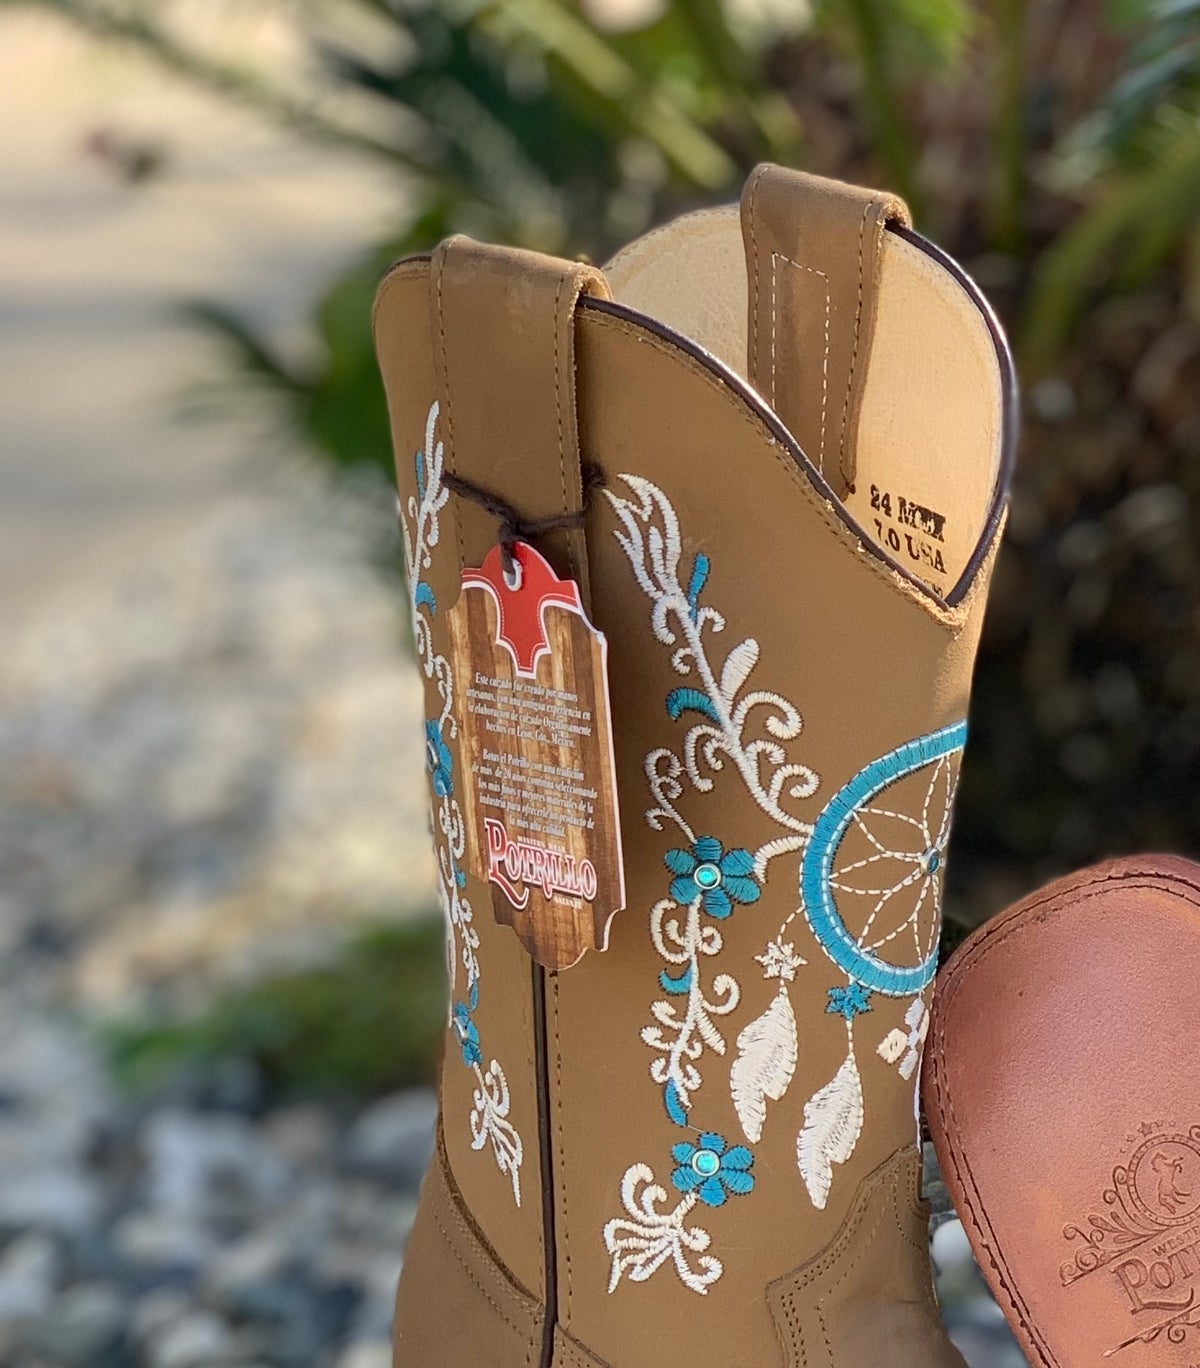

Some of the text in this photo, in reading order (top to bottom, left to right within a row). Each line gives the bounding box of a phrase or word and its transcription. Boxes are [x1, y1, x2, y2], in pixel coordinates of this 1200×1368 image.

[869, 484, 892, 518] 24
[904, 533, 947, 574] USA
[475, 672, 489, 686] Este
[513, 680, 524, 692] fue
[511, 710, 519, 721] de
[582, 711, 591, 720] en
[578, 800, 587, 812] de
[587, 817, 596, 830] de
[517, 835, 546, 848] WESTERN
